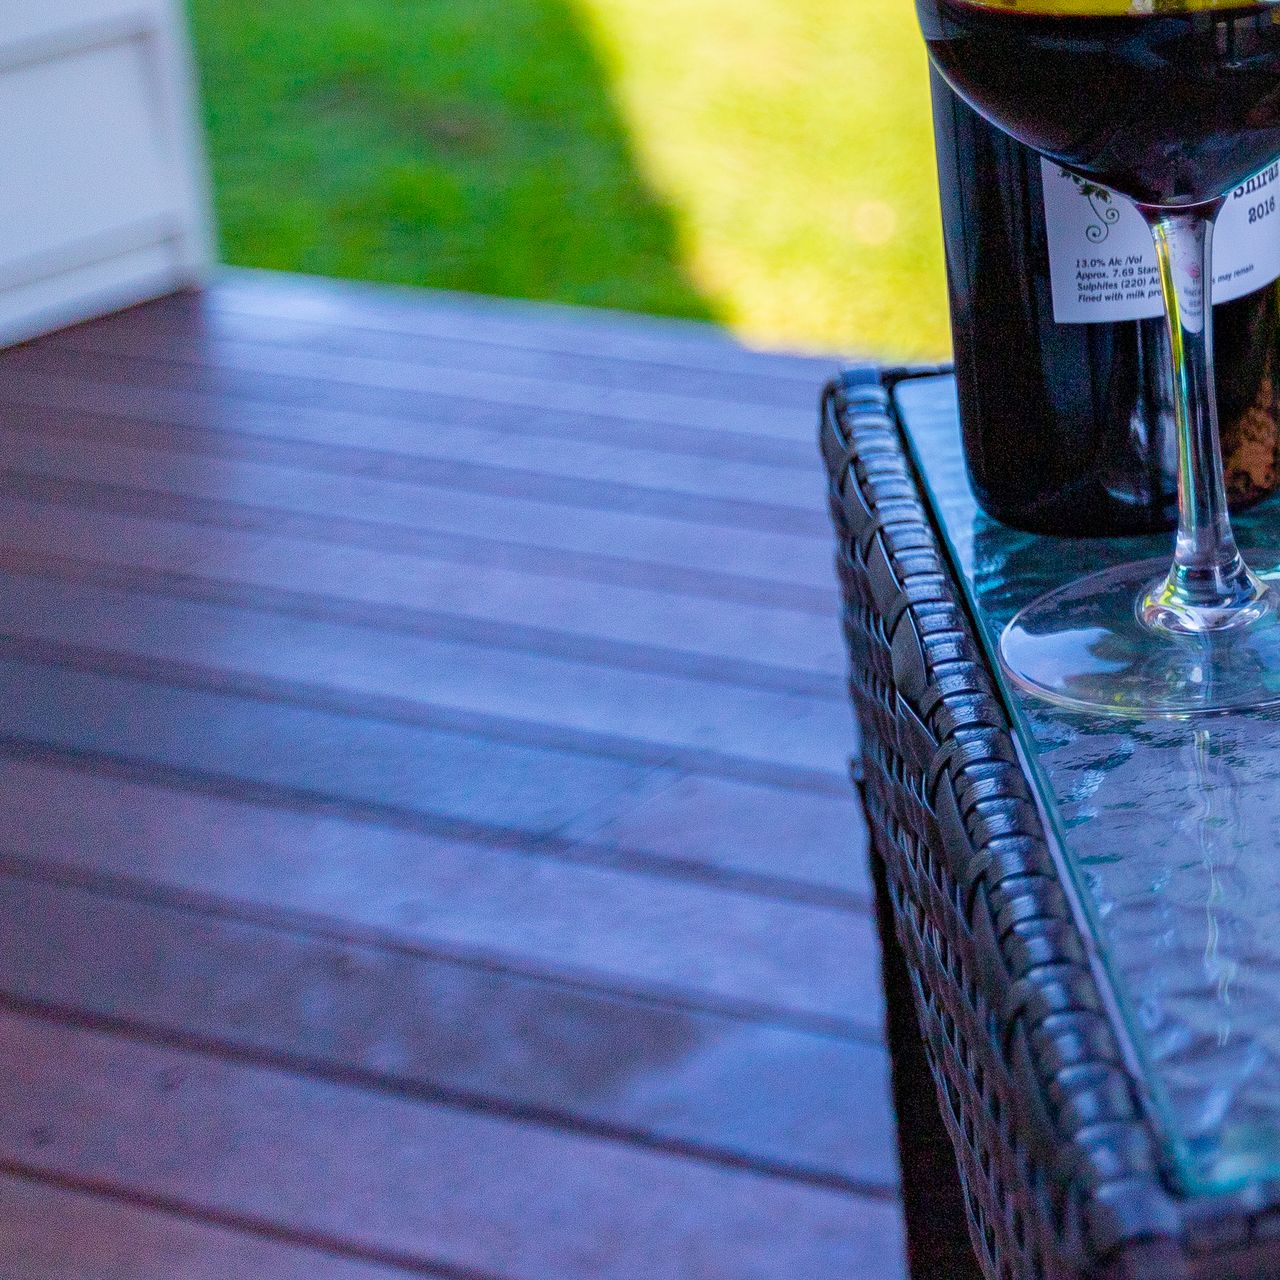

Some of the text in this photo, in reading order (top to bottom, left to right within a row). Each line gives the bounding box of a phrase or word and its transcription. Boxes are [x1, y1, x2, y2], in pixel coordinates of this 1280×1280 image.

[1248, 196, 1275, 224] 2016
[1076, 259, 1105, 268] 13.0%
[1108, 257, 1122, 267] Alc
[1075, 270, 1109, 280] Approx.
[1113, 268, 1134, 278] 7.69
[1077, 280, 1118, 292] Sulphites
[1121, 278, 1146, 289] (220)
[1078, 293, 1102, 302] Fined
[1104, 292, 1123, 301] with
[1126, 290, 1145, 300] milk
